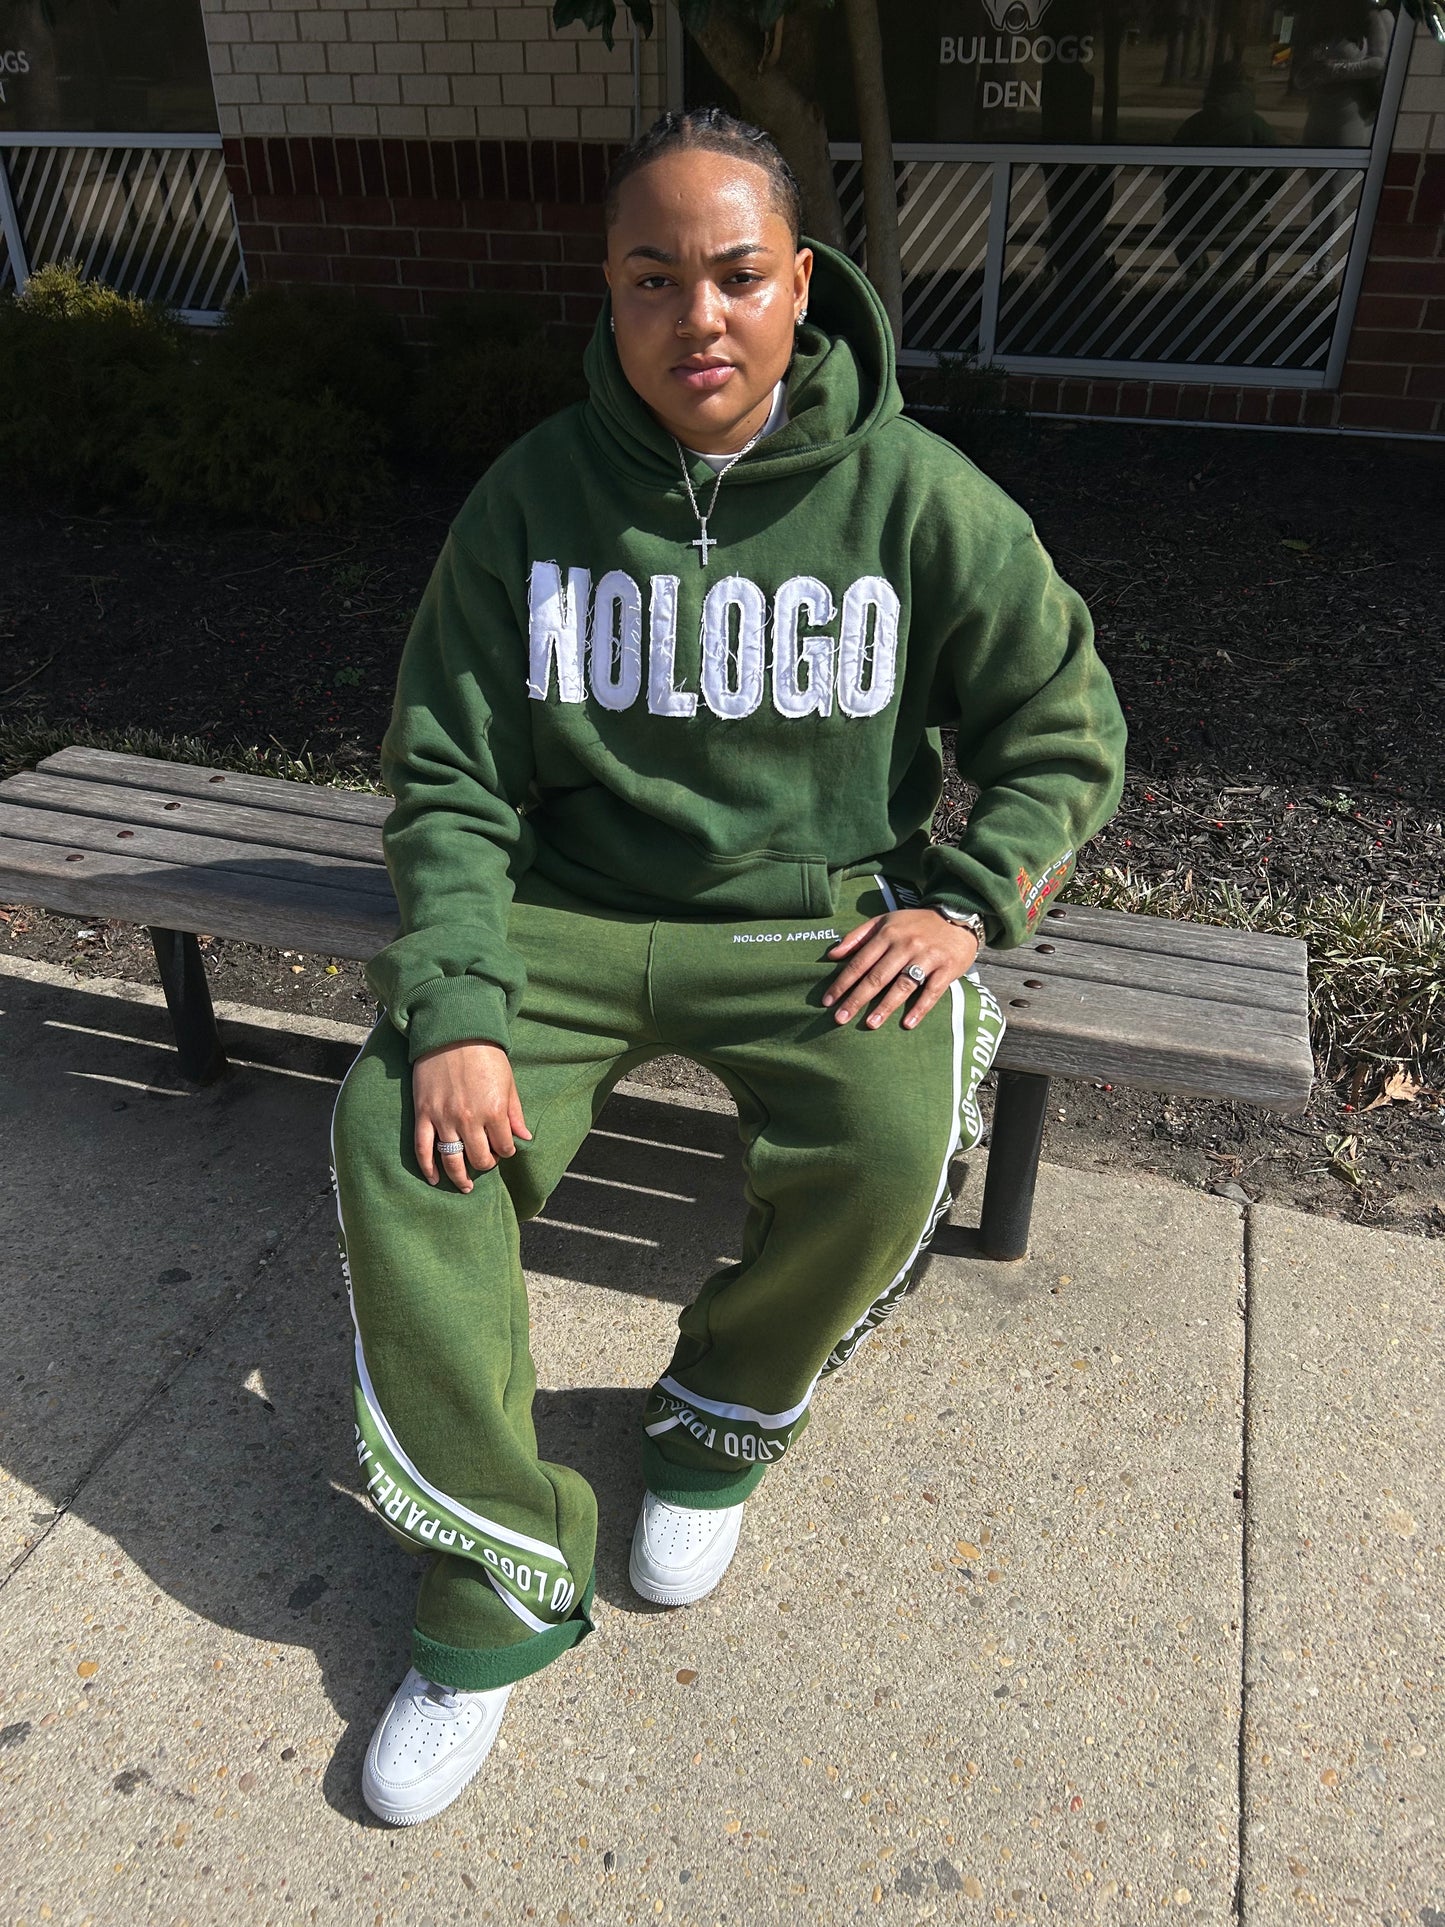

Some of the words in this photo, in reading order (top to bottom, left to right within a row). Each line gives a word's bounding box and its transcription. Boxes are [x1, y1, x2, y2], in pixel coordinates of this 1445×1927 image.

[940, 35, 1094, 64] BULLDOGS
[983, 80, 1042, 109] DEN
[526, 560, 901, 720] NOLOGO
[786, 928, 840, 943] APPAREL
[366, 1461, 476, 1552] APPAREL
[483, 1548, 549, 1604] LOGO
